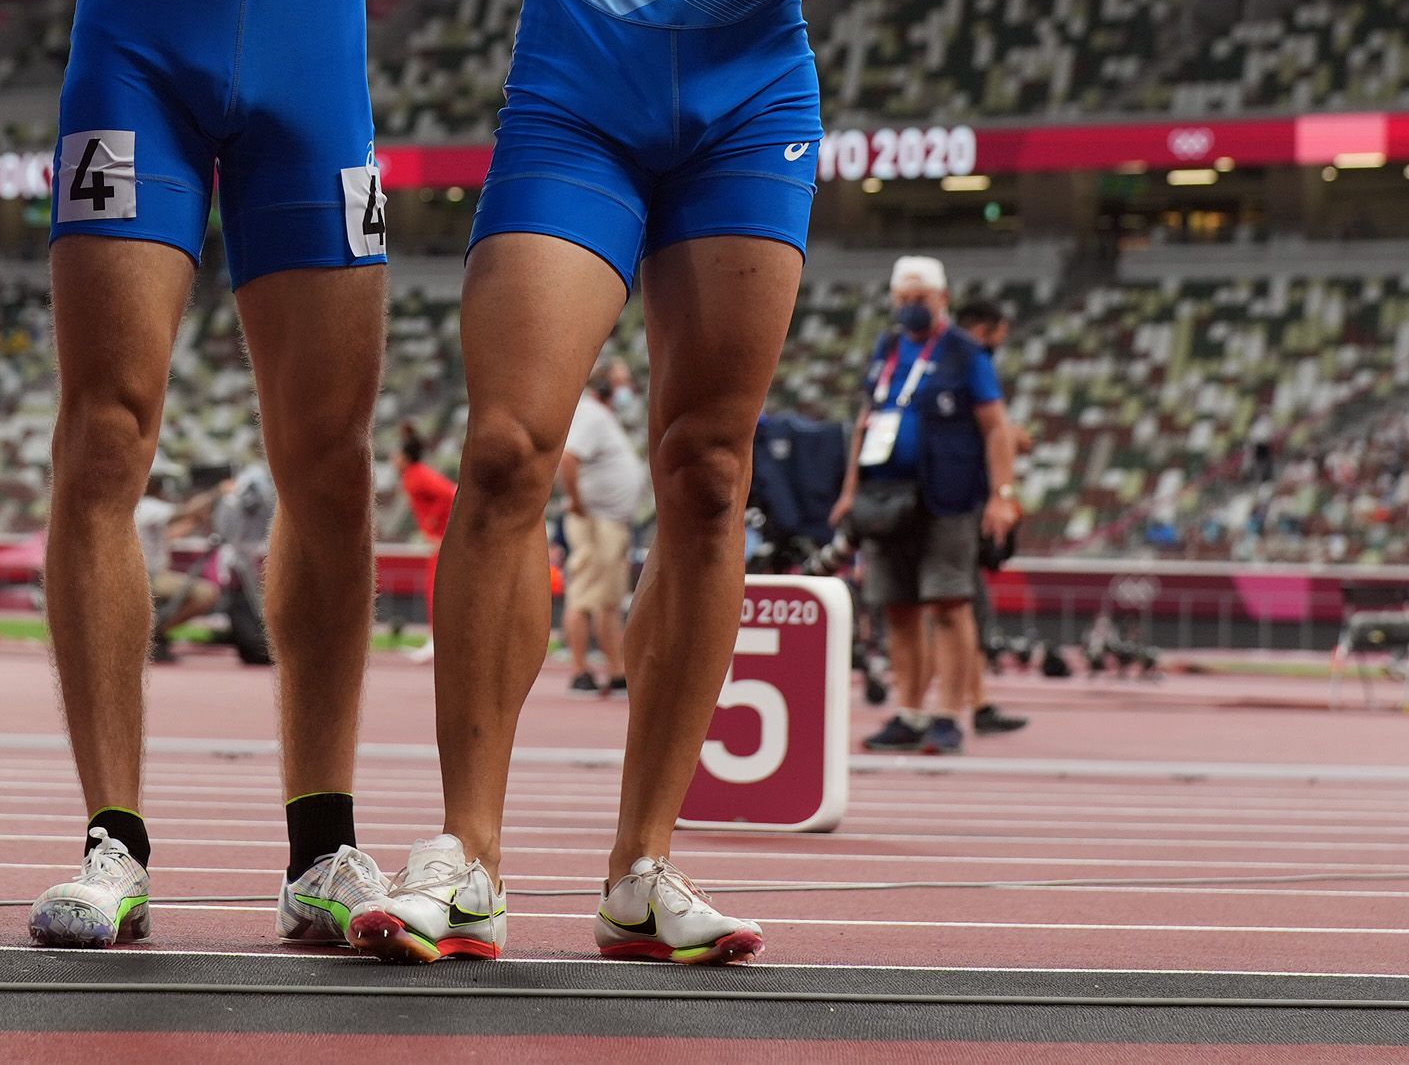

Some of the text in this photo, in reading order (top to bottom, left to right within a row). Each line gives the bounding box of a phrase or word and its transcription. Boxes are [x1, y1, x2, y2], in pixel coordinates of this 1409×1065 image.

[69, 137, 115, 211] 4
[870, 124, 977, 180] 2020
[362, 174, 385, 246] 4
[757, 598, 819, 625] 2020
[699, 626, 789, 784] 5
